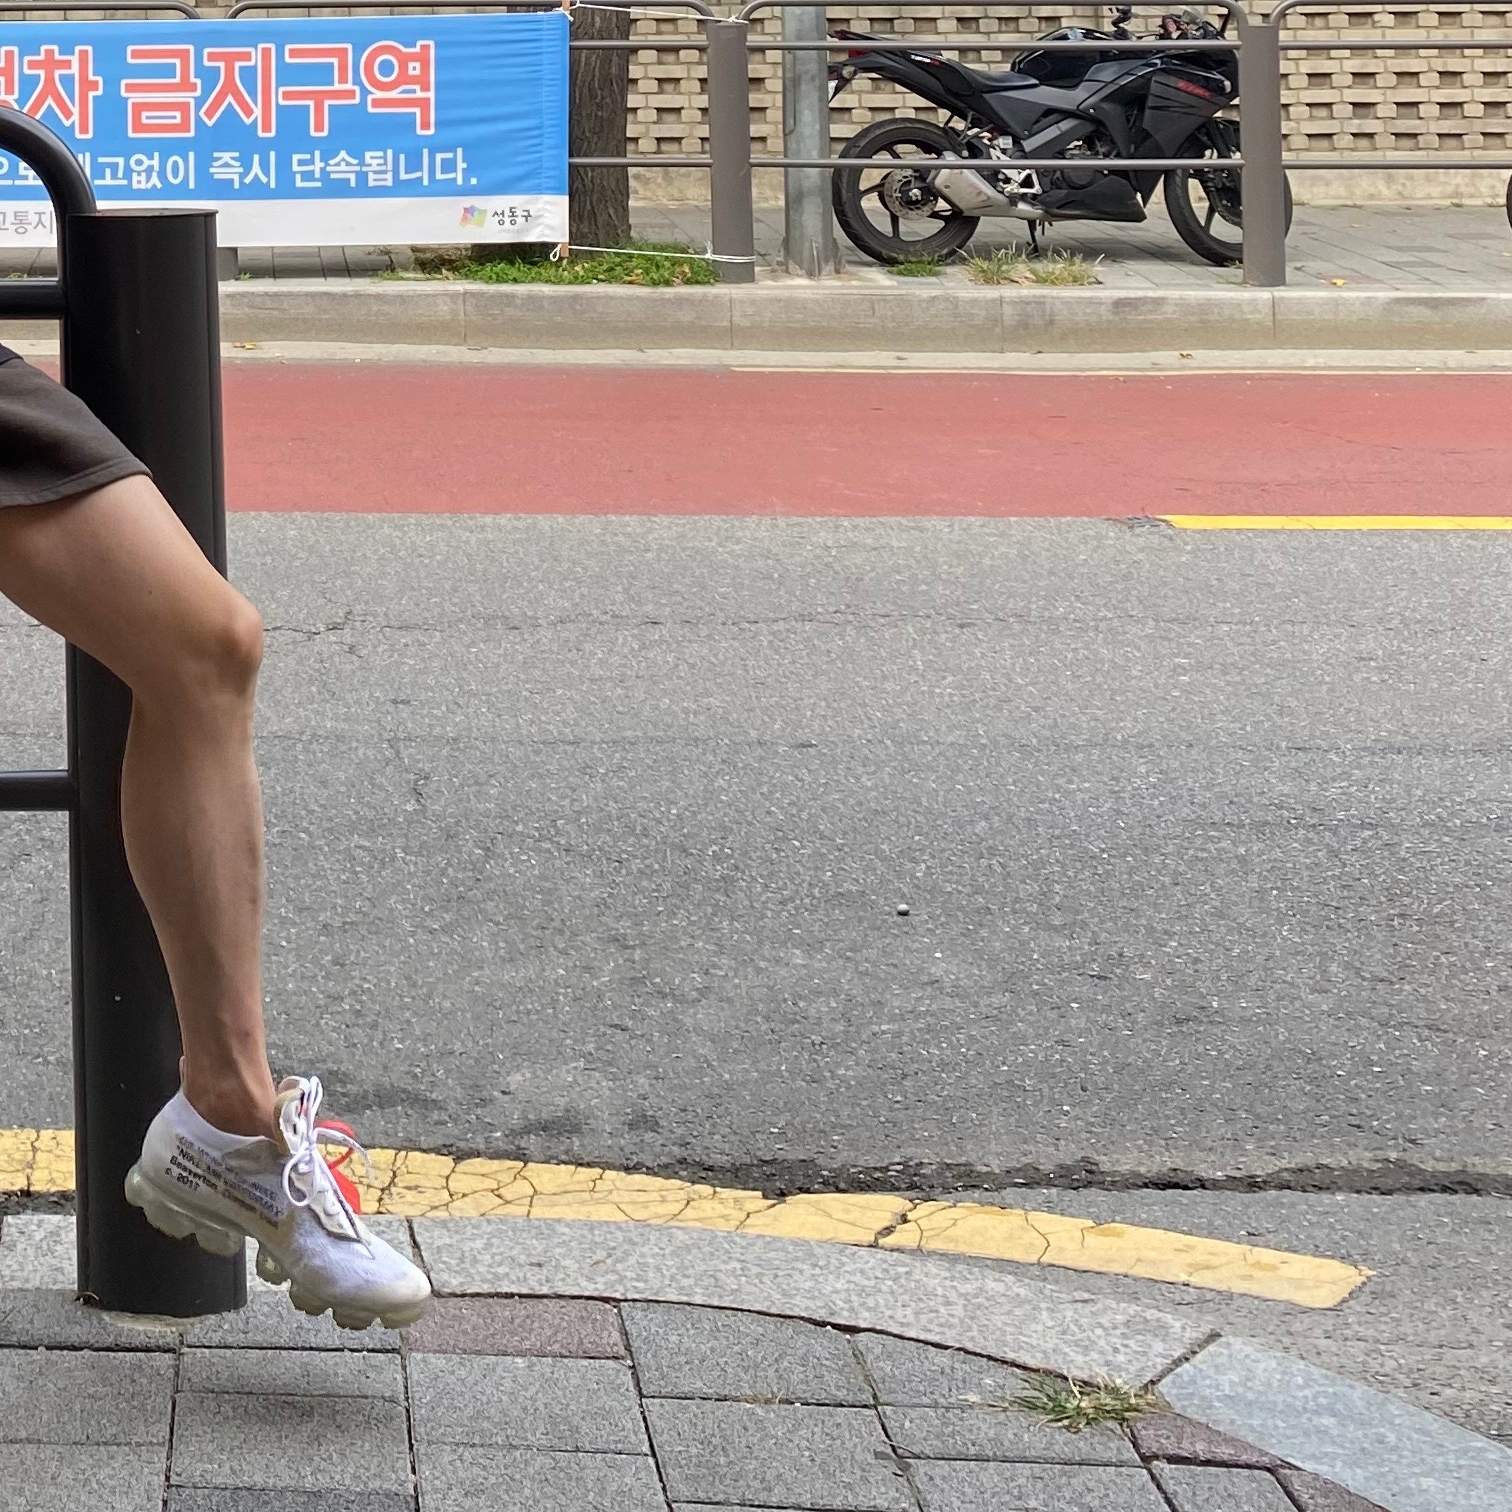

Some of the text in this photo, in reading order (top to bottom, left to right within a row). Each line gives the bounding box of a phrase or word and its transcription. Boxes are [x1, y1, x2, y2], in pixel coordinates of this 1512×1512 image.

[120, 40, 436, 138] 금지구역
[209, 150, 276, 189] 즉시
[291, 147, 477, 189] 단속됩니다.
[491, 206, 532, 226] 성동구
